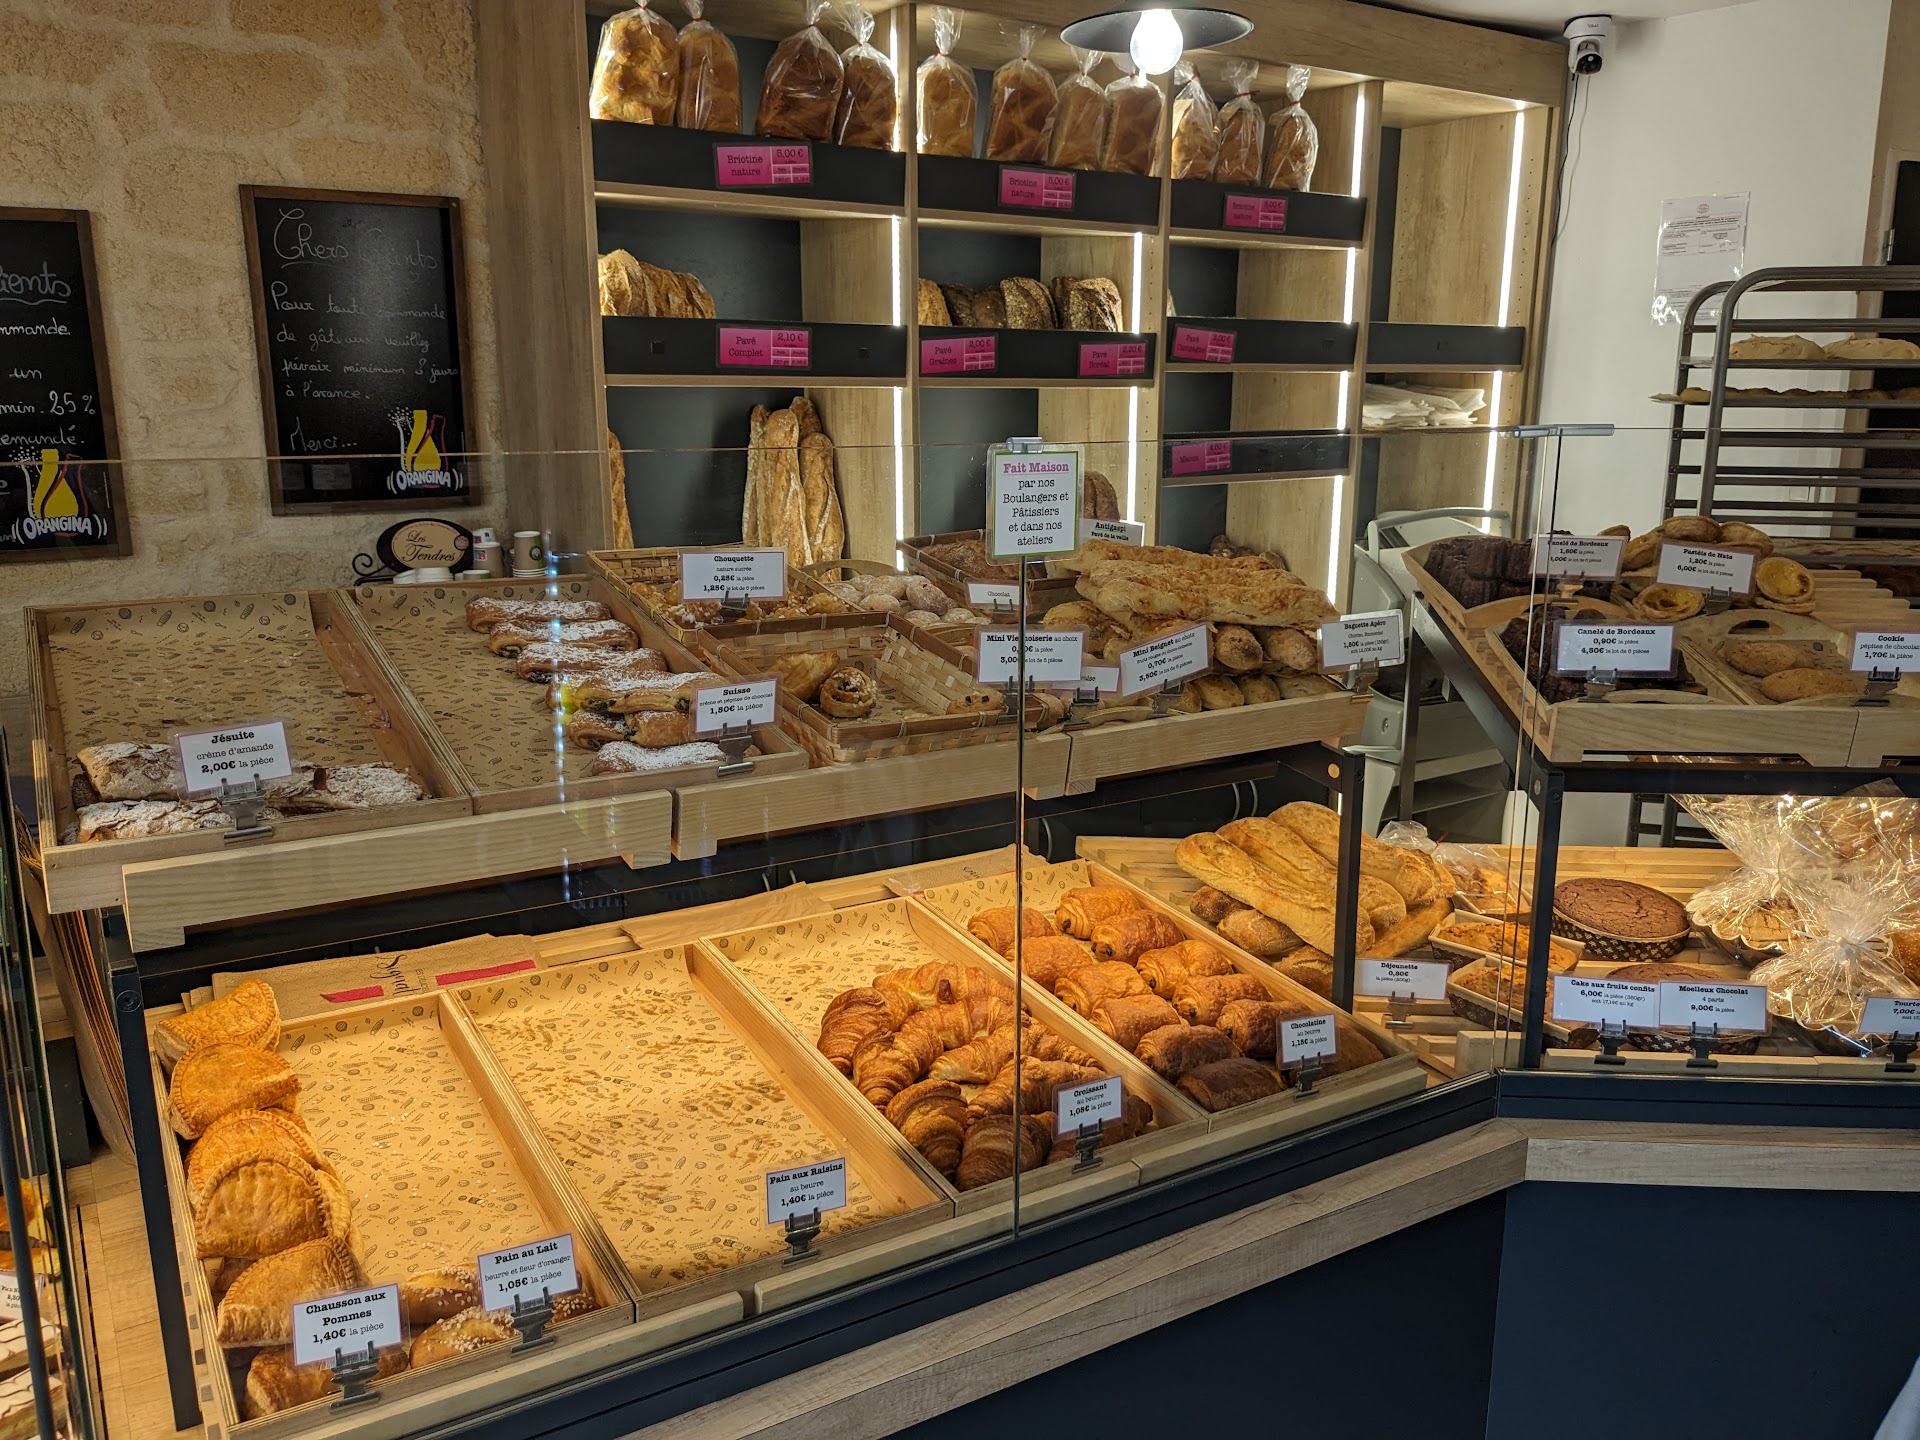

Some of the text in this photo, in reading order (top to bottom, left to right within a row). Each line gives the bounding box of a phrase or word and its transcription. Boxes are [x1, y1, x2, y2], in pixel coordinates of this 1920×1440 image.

[797, 148, 804, 158] €
[731, 168, 761, 176] nature
[271, 281, 315, 310] Pour
[276, 323, 297, 342] de
[777, 332, 803, 342] 2,10 €
[736, 336, 757, 345] Pavé
[986, 339, 991, 347] €
[728, 348, 763, 358] Complet
[934, 346, 952, 354] Pavé
[9, 368, 42, 379] un
[282, 357, 332, 377] prévoir
[343, 363, 406, 375] minimum
[429, 363, 459, 384] jours
[285, 384, 295, 397] à
[49, 390, 76, 415] 25
[82, 394, 96, 415] %
[1003, 462, 1070, 474] Fait Maison
[396, 470, 451, 490] ORANGINA
[1018, 479, 1055, 490] par nos
[1002, 492, 1070, 504] Boulangers et
[1012, 507, 1060, 518] Pâtissiers
[23, 516, 93, 540] ORANGINA
[1008, 521, 1063, 532] et dans nos
[405, 529, 426, 543] Les
[1016, 535, 1053, 546] ateliers
[402, 544, 456, 562] Tendres
[1344, 622, 1369, 630] Baguette
[1132, 639, 1174, 657] Mini Beignet
[1581, 647, 1605, 655] 4,50€
[722, 687, 751, 696] Suisse
[709, 705, 735, 715] 1,50€
[211, 731, 255, 744] Jésuite
[228, 743, 274, 756] d'amande
[201, 756, 274, 774] 2,00€ la pièce
[1381, 962, 1418, 970] Déjeunette
[1571, 979, 1590, 987] Cake
[1606, 982, 1628, 990] fruits
[1630, 985, 1655, 993] confits
[1679, 985, 1748, 995] Moelleux Chocolat
[1580, 989, 1603, 997] 6,00€
[1290, 1019, 1326, 1029] Chocolatine
[1073, 1083, 1108, 1097] Croissant
[769, 1163, 843, 1184] Pain aux Raisins
[800, 1180, 824, 1191] beurre
[781, 1194, 807, 1207] 1,40€
[494, 1241, 558, 1265] Pain au Lait
[484, 1255, 571, 1282] beurre et fleur d'oranger
[498, 1270, 562, 1293] 1,05€ la pièce
[306, 1292, 386, 1315] Chausson aux
[322, 1309, 372, 1326] Pommes
[313, 1322, 385, 1344] 1,40€ la pièce
